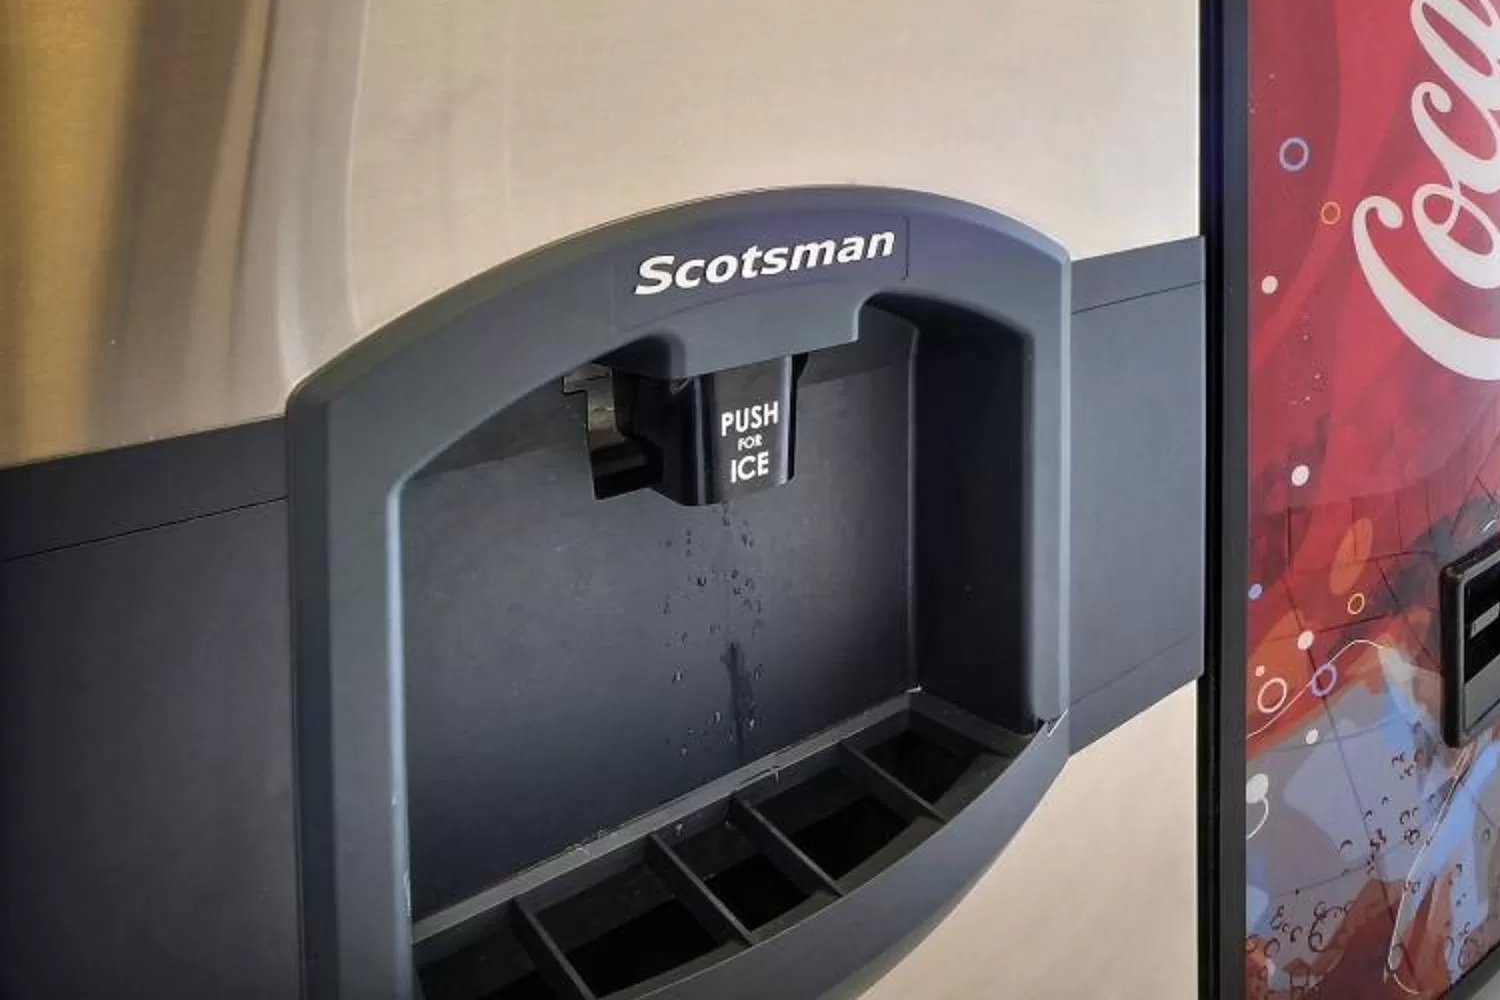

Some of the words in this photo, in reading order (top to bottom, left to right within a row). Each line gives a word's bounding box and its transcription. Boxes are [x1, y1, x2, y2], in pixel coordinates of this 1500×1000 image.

[635, 231, 895, 295] Scotsman
[721, 401, 779, 436] PUSH
[737, 434, 763, 450] FOR
[731, 452, 769, 483] ICE
